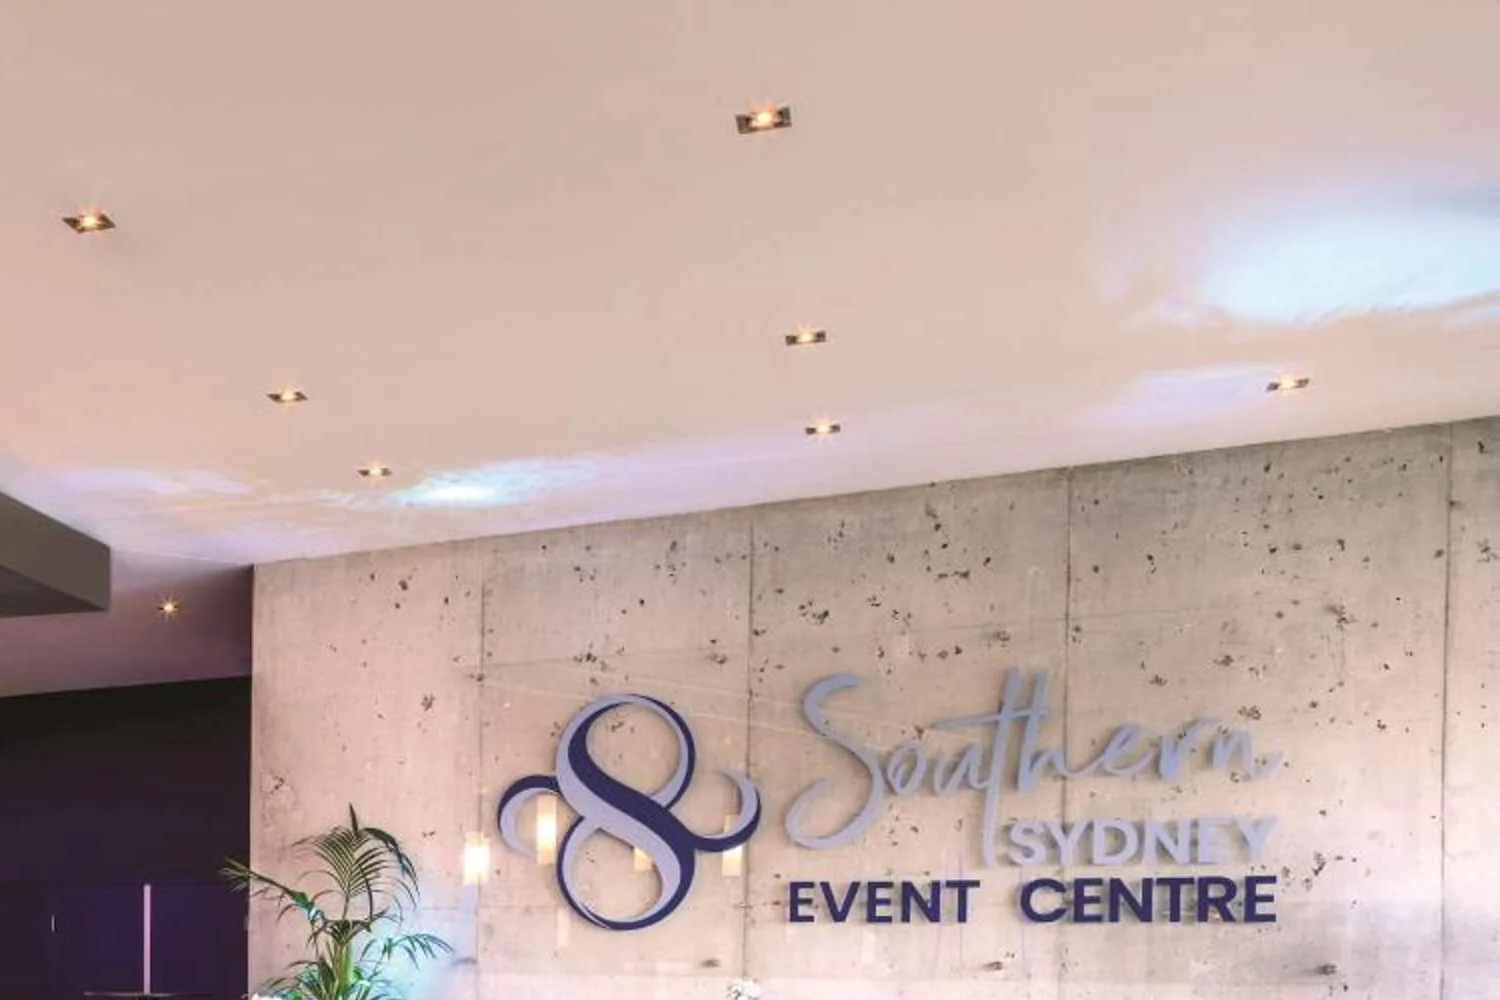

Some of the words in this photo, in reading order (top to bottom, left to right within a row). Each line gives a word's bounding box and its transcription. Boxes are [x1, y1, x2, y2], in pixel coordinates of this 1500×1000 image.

[785, 667, 1285, 868] Southern
[1008, 815, 1279, 867] SYDNEY
[788, 879, 981, 923] EVENT
[1019, 875, 1278, 923] CENTRE
